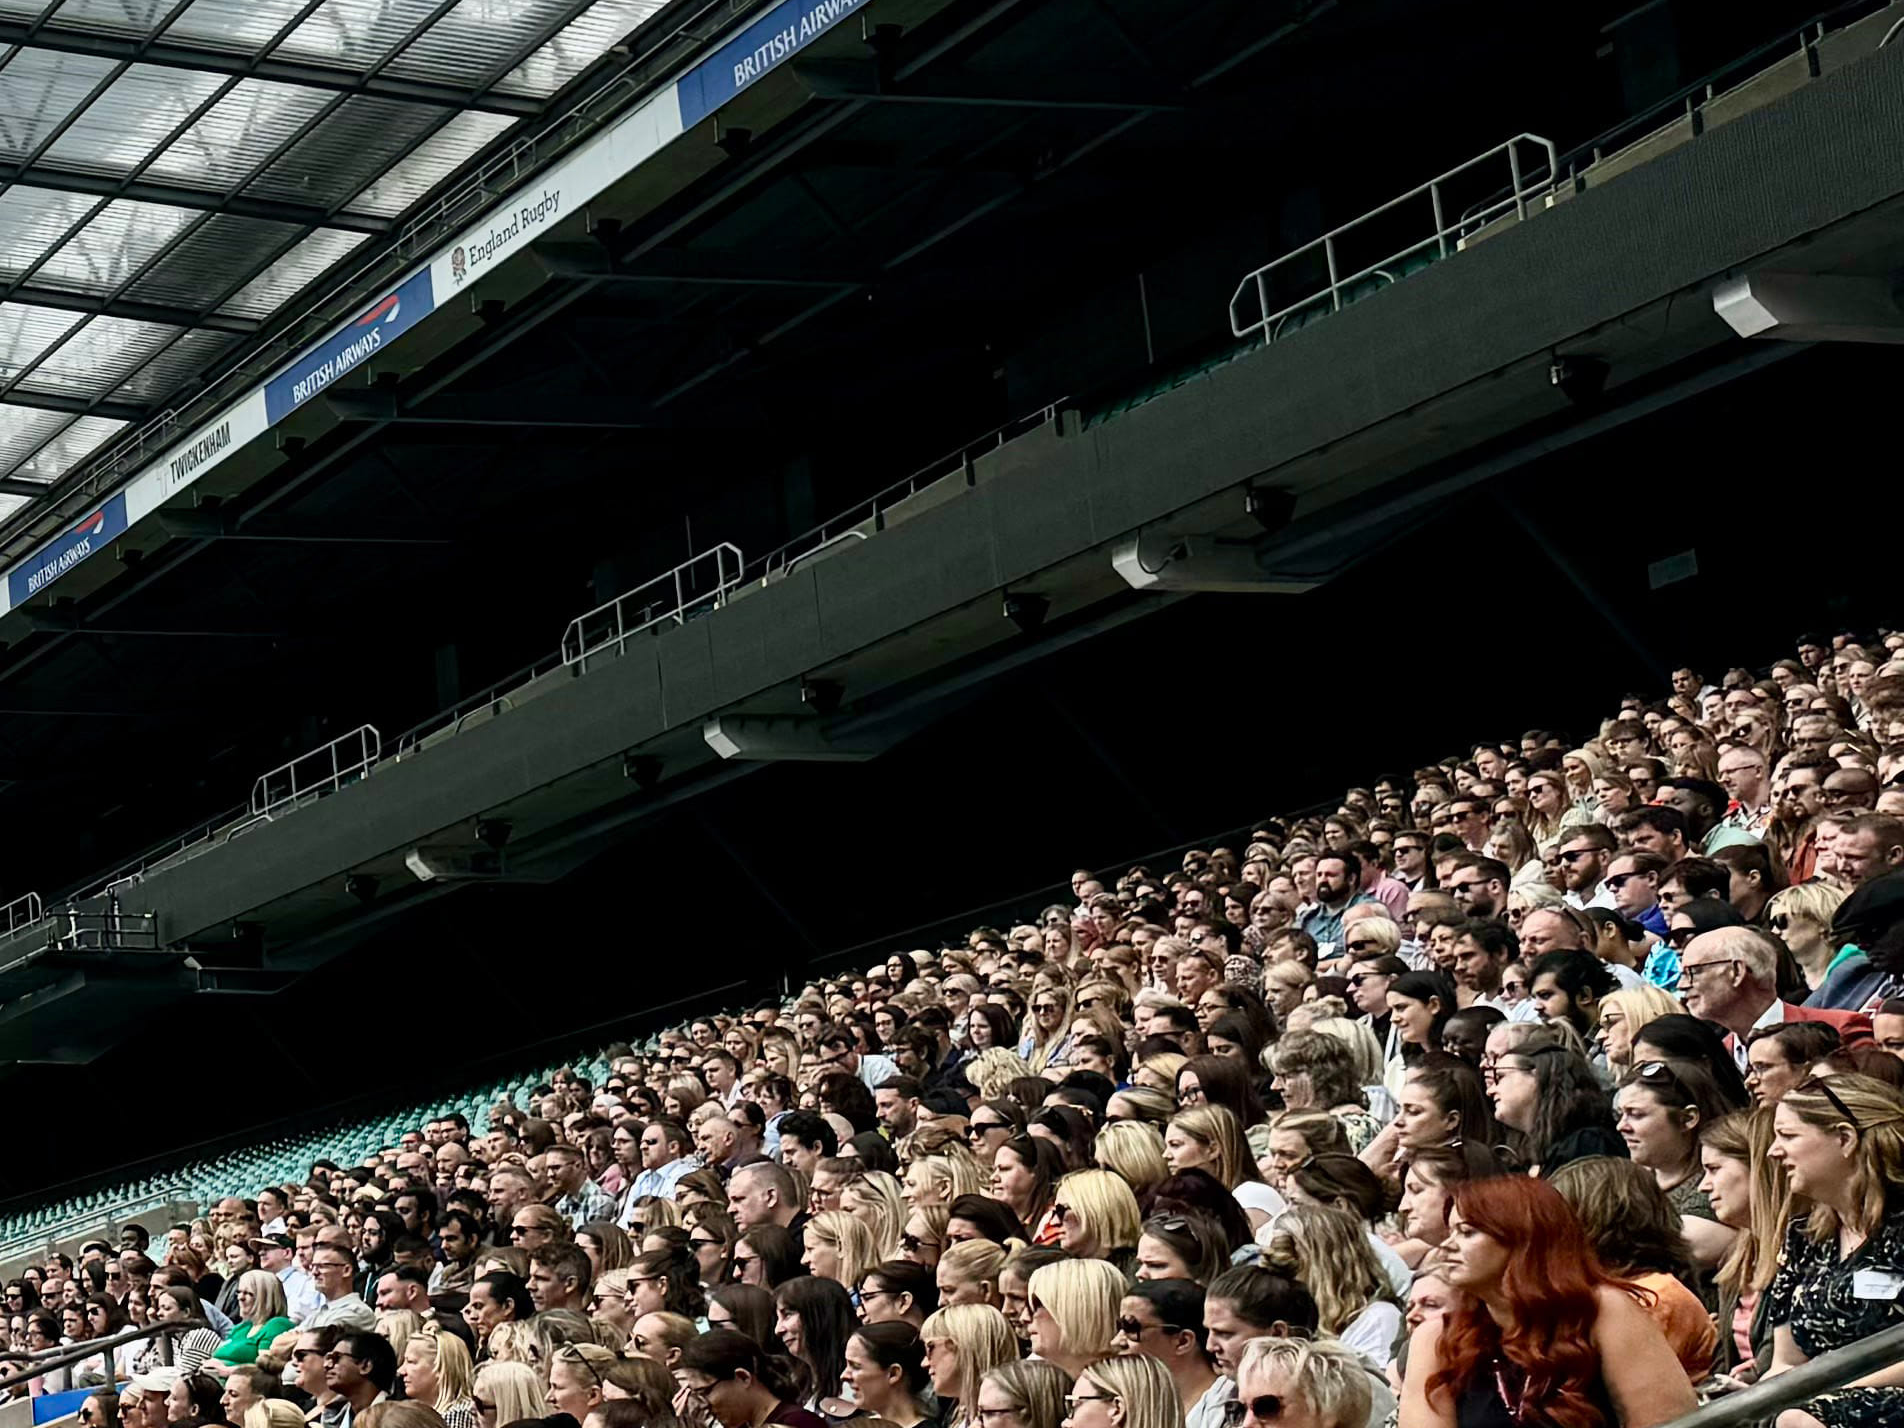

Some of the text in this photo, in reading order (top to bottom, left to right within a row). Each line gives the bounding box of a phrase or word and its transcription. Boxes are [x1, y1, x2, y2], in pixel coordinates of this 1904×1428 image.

[733, 25, 797, 88] BRITISH
[468, 190, 561, 267] England Rugby
[292, 326, 381, 404] BRITISH AIRWAYS
[169, 420, 232, 485] TWICKENHAM
[27, 539, 91, 594] BRITISH AIRWAYS
